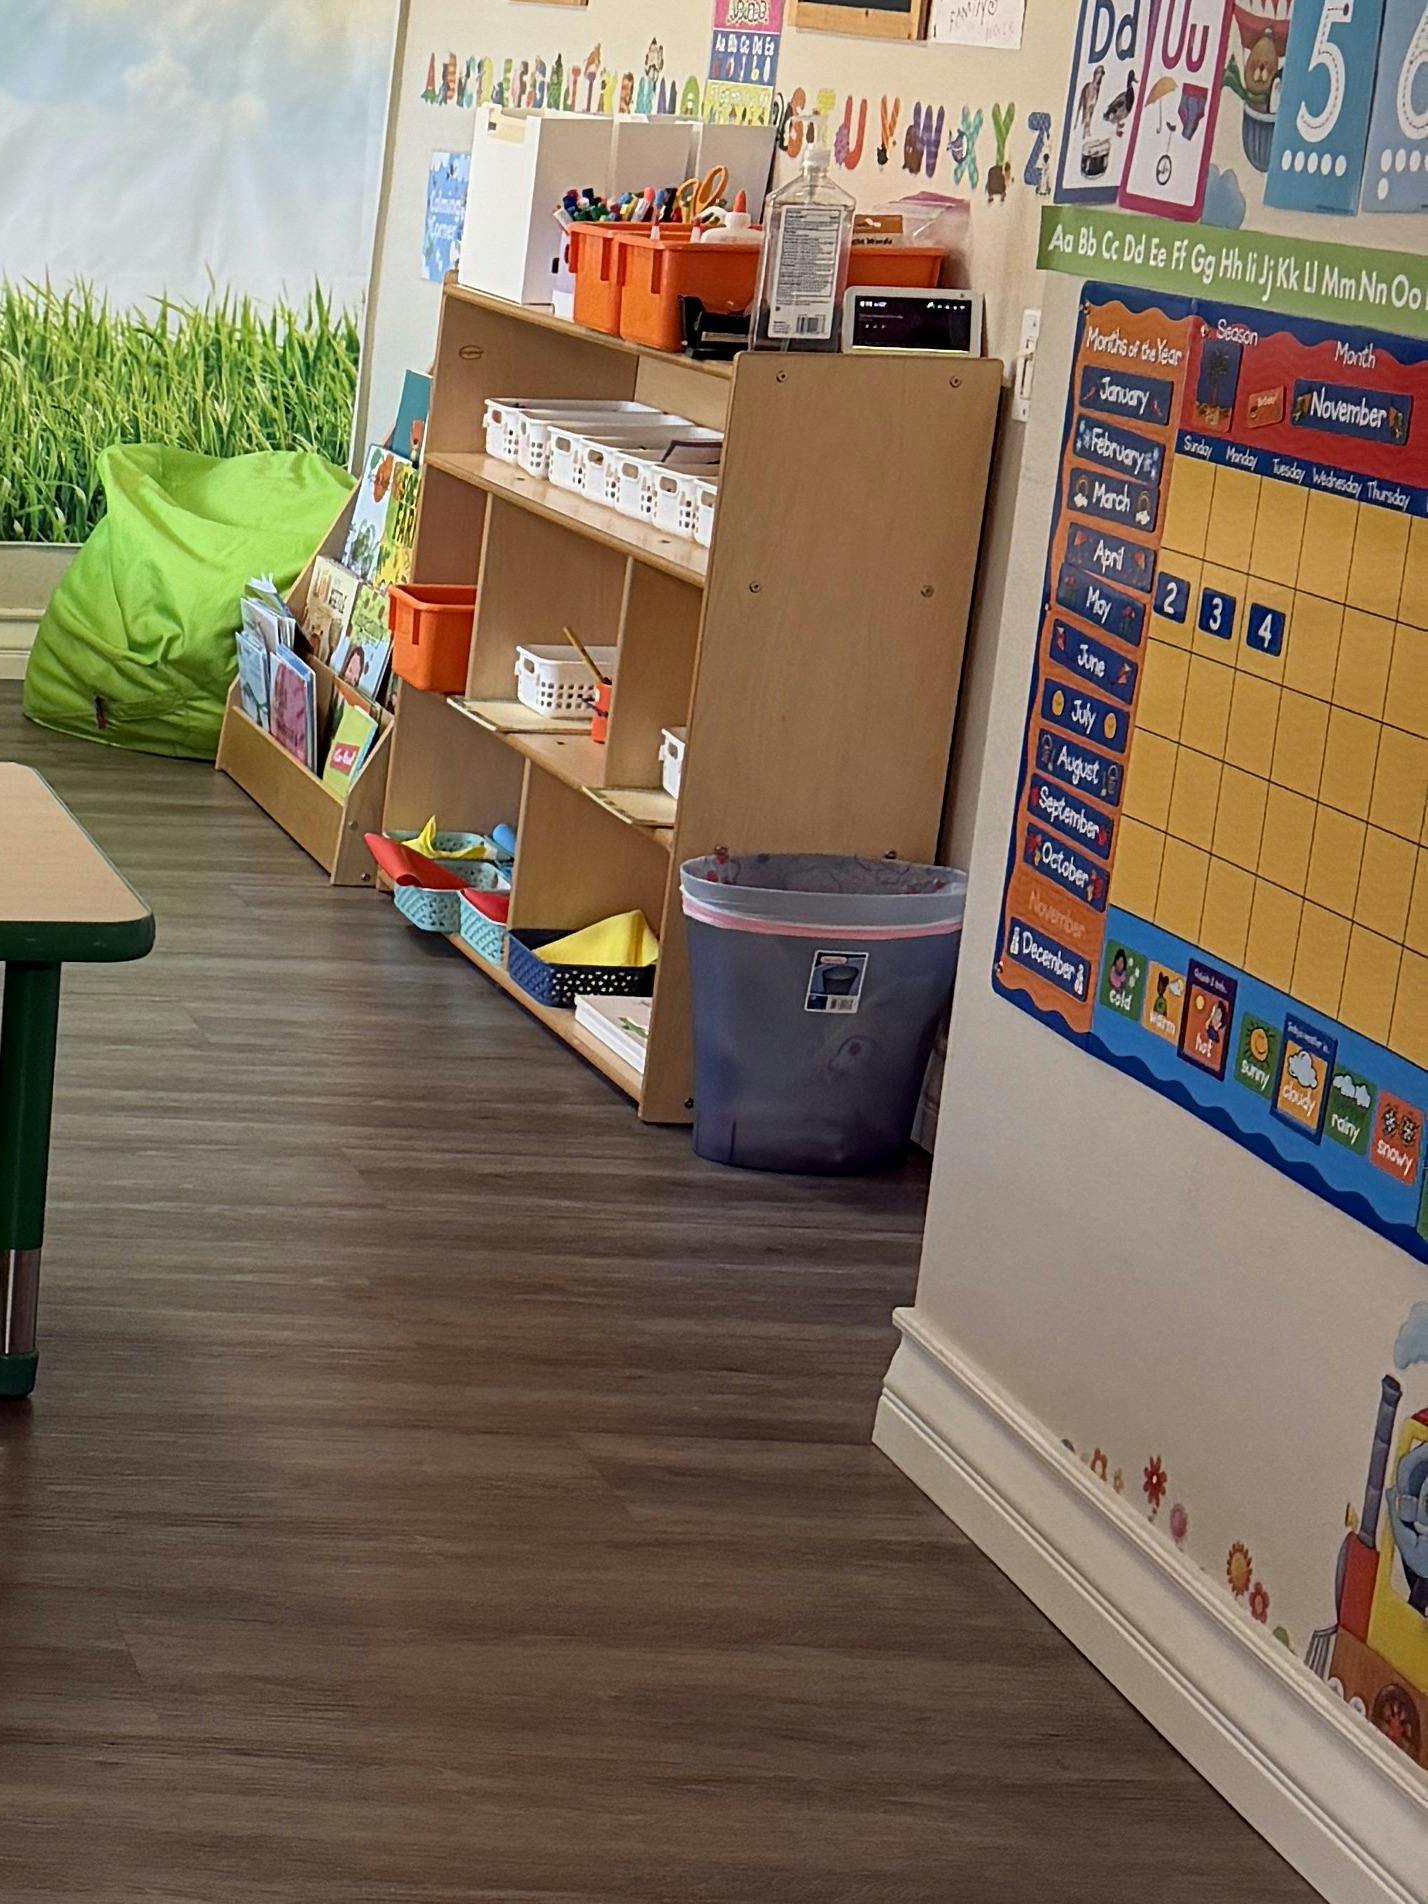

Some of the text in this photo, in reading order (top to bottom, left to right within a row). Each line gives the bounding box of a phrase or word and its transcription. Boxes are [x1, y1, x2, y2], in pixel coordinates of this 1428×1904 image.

[1048, 224, 1421, 310] Aa Bb Cc Dd Ee Ff Gg Hh Ii Jj Kk Ll Mm Nn Oo
[1086, 326, 1182, 367] Months of the Year
[1217, 319, 1258, 346] Season
[1335, 340, 1376, 369] Month
[1100, 376, 1150, 415] January
[1309, 387, 1387, 429] November
[1090, 427, 1145, 474] February
[1183, 434, 1411, 513] Sunday Monday Tuesday Wednesday Thursday
[1093, 481, 1131, 512] March
[1094, 539, 1125, 574] April
[1086, 586, 1112, 624] May
[1164, 582, 1272, 648] 2 3 4
[1078, 645, 1105, 677] June
[1072, 700, 1097, 734] July
[1057, 746, 1099, 785] August
[1039, 786, 1100, 841] September
[1042, 842, 1089, 888] October
[1030, 890, 1085, 939] November
[1023, 931, 1076, 982] December
[1109, 988, 1132, 1011] cold
[1149, 1011, 1176, 1036] warm
[1195, 1032, 1212, 1058] hot
[1241, 1059, 1270, 1090] sunny
[1283, 1082, 1315, 1118] cloudy
[1331, 1113, 1361, 1145] rainy
[1377, 1139, 1413, 1176] snowy
